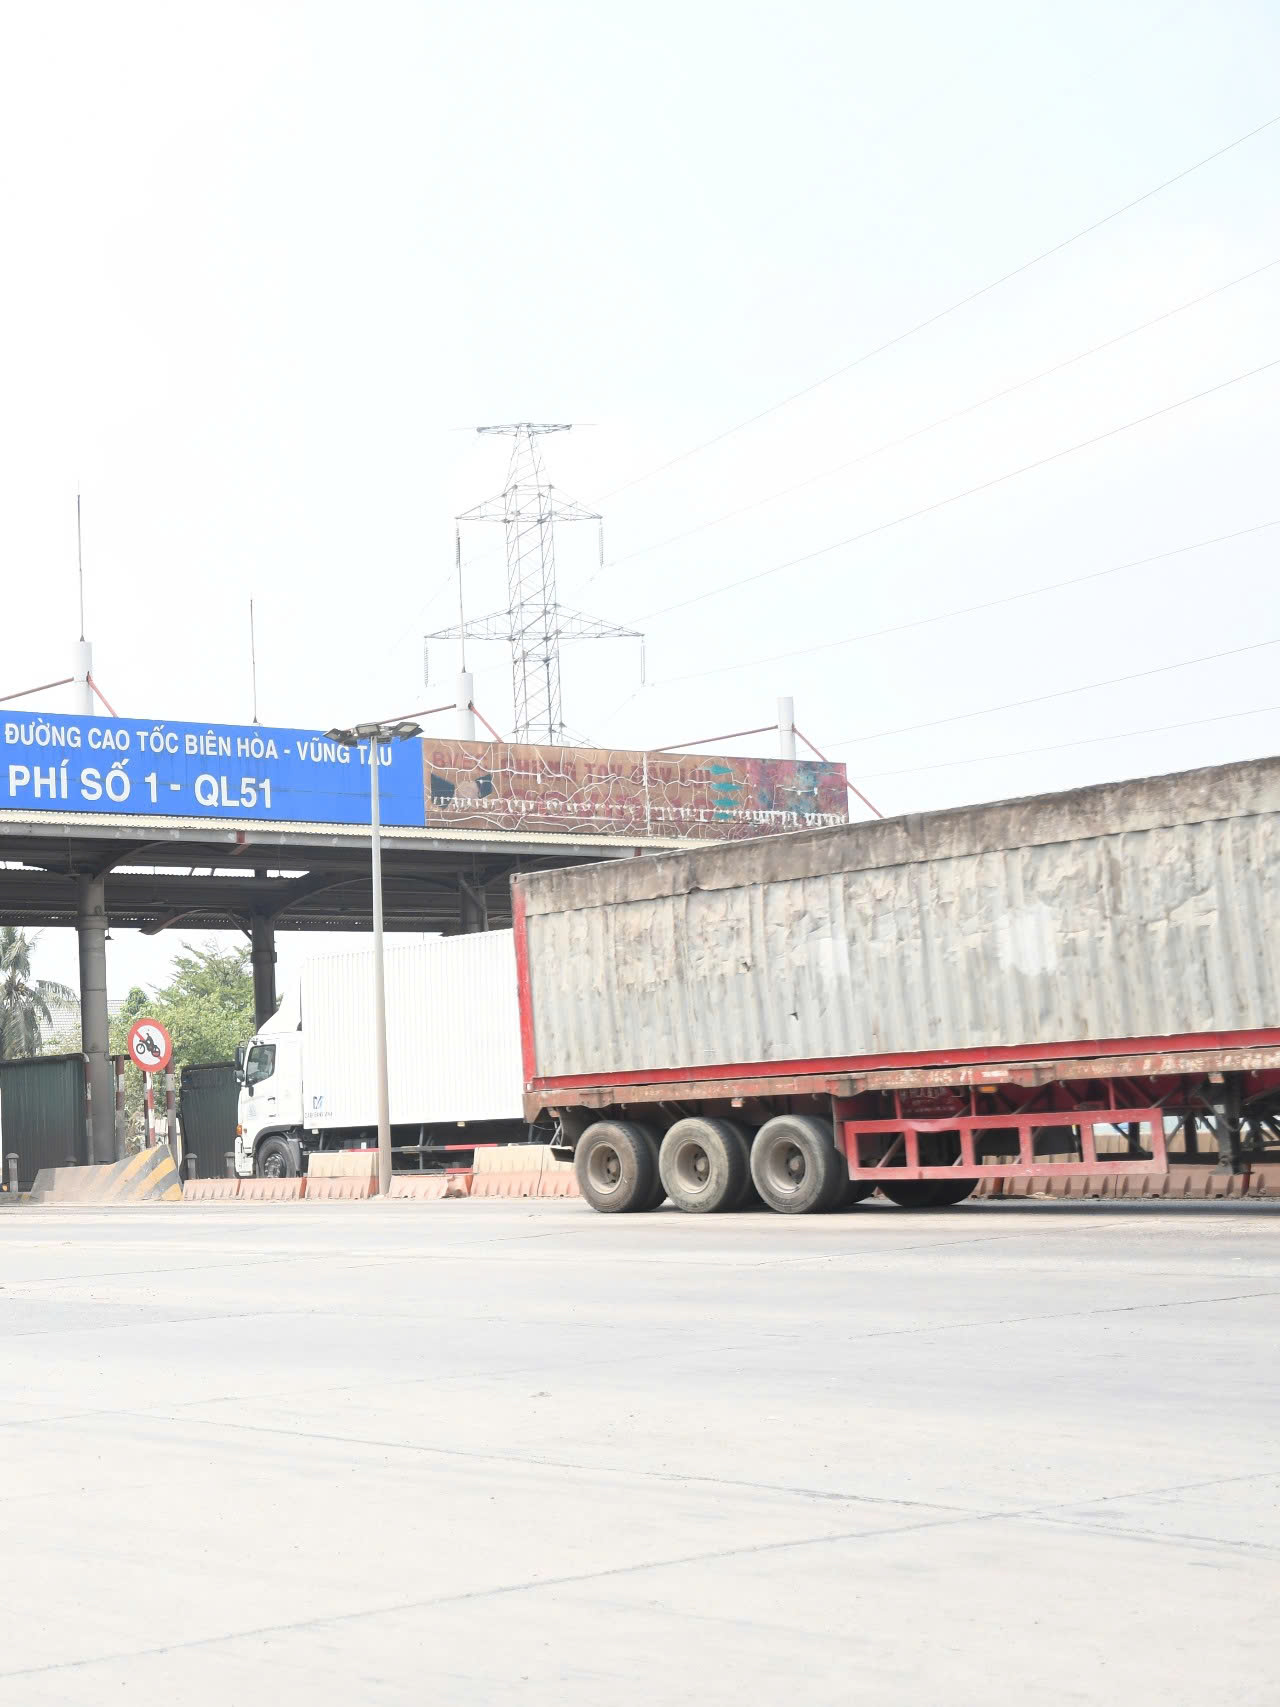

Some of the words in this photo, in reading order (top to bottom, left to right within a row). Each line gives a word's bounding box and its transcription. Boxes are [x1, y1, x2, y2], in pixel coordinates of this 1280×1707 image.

[4, 718, 82, 748] ĐƯỜNG
[87, 728, 130, 751] CAO
[136, 725, 179, 754] TỐC
[185, 730, 231, 757] BIÊN
[236, 732, 279, 760] HÒA
[296, 737, 350, 764] VŨNG
[9, 759, 69, 799] PHÍ
[80, 758, 131, 802] SỐ
[144, 772, 158, 803] 1
[194, 774, 271, 809] QL51
